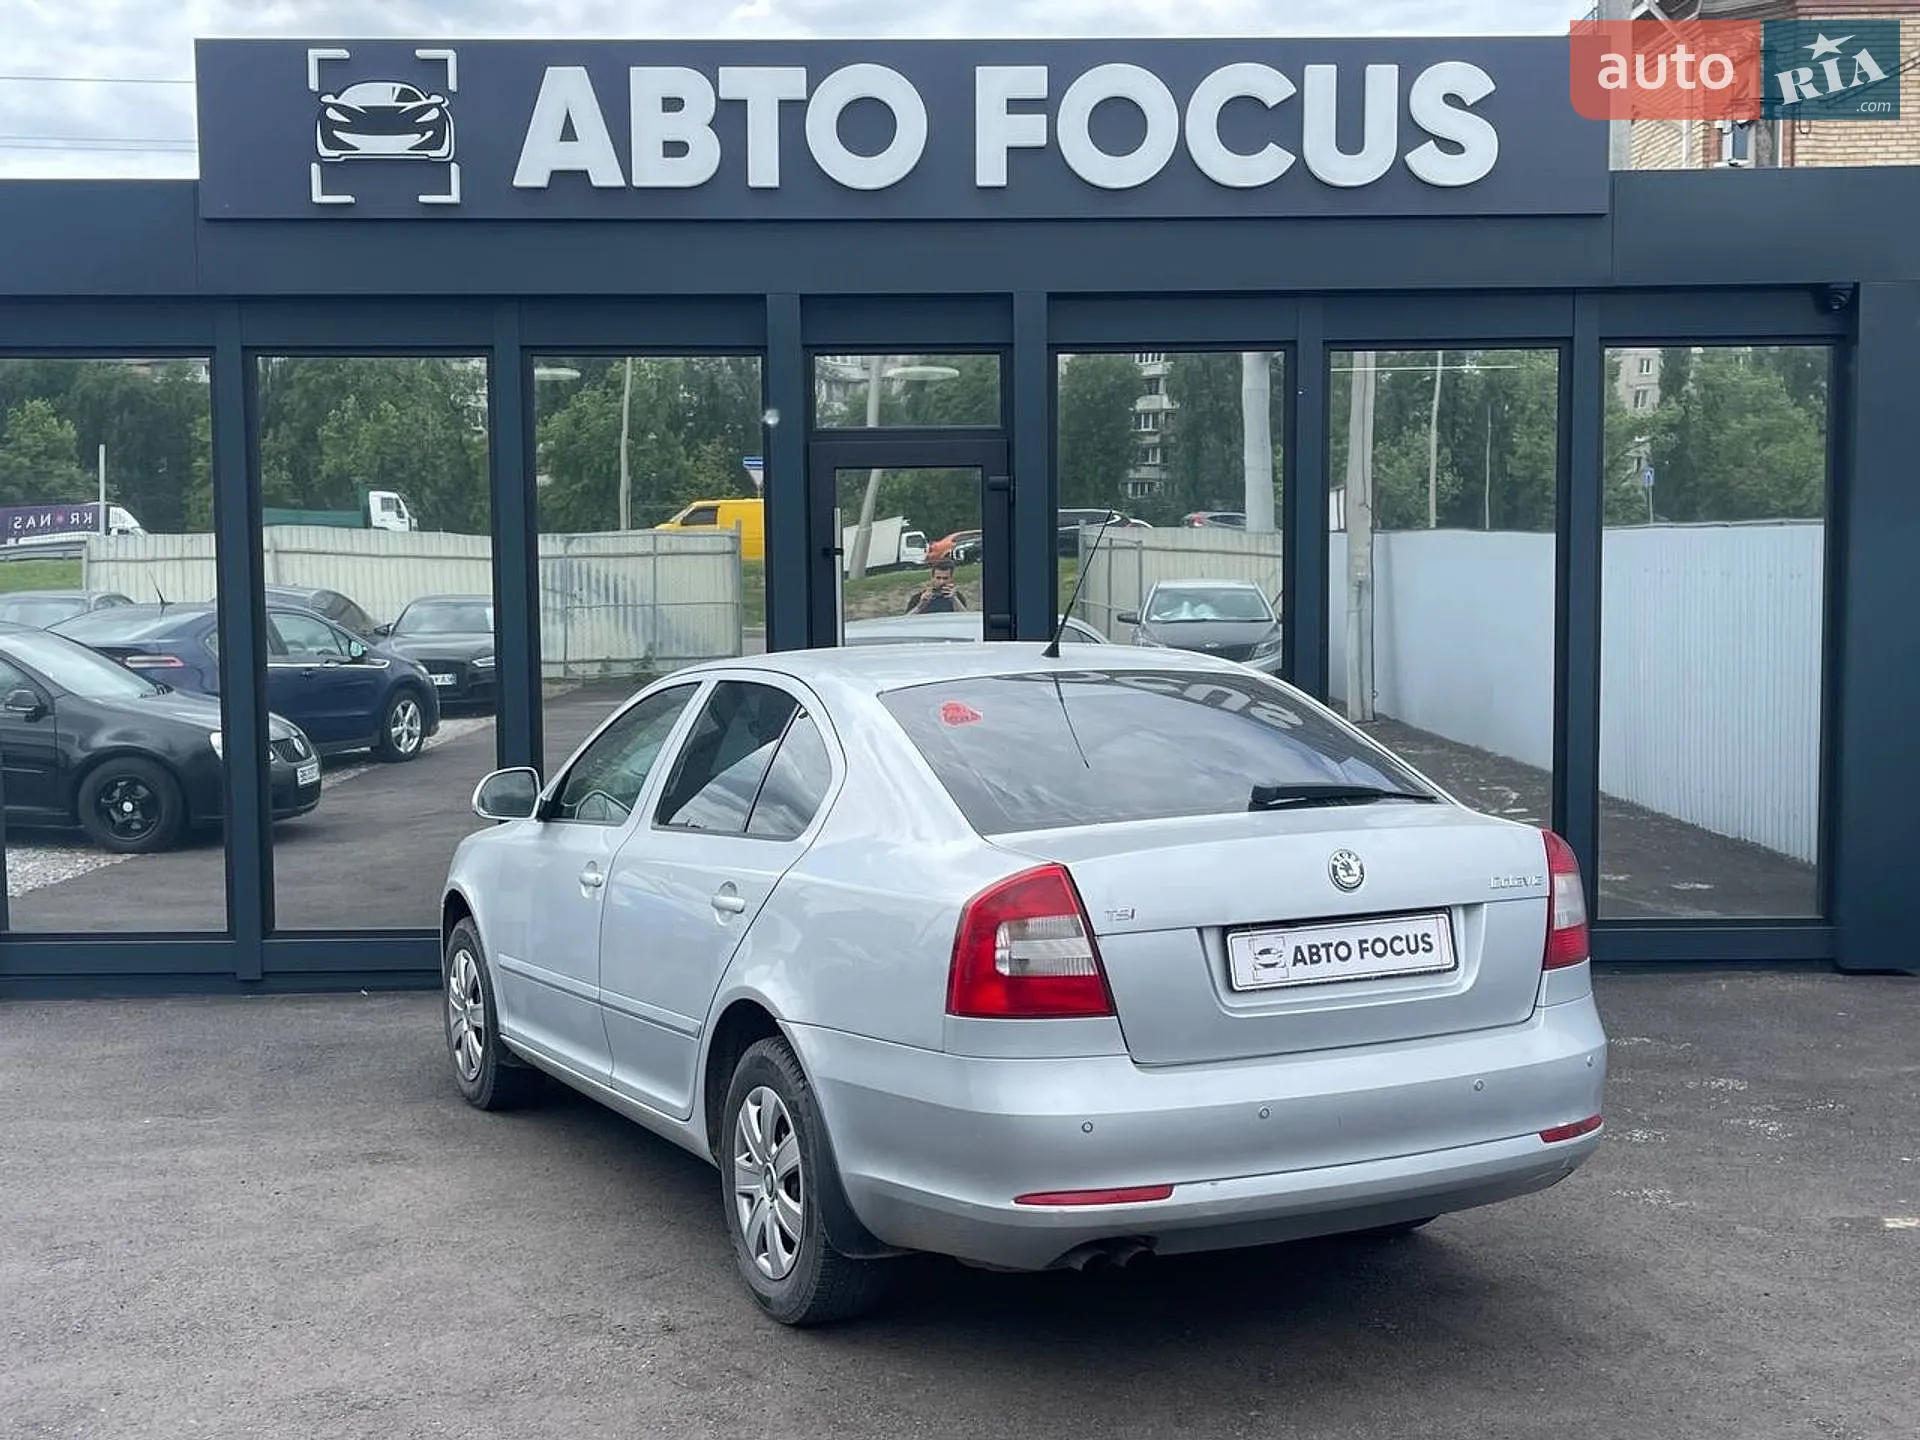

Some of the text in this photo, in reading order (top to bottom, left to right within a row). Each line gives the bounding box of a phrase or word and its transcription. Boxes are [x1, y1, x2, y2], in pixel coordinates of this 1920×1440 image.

[511, 61, 1499, 191] АВТО FOCUS
[1291, 932, 1434, 967] АВТО FOCUS
